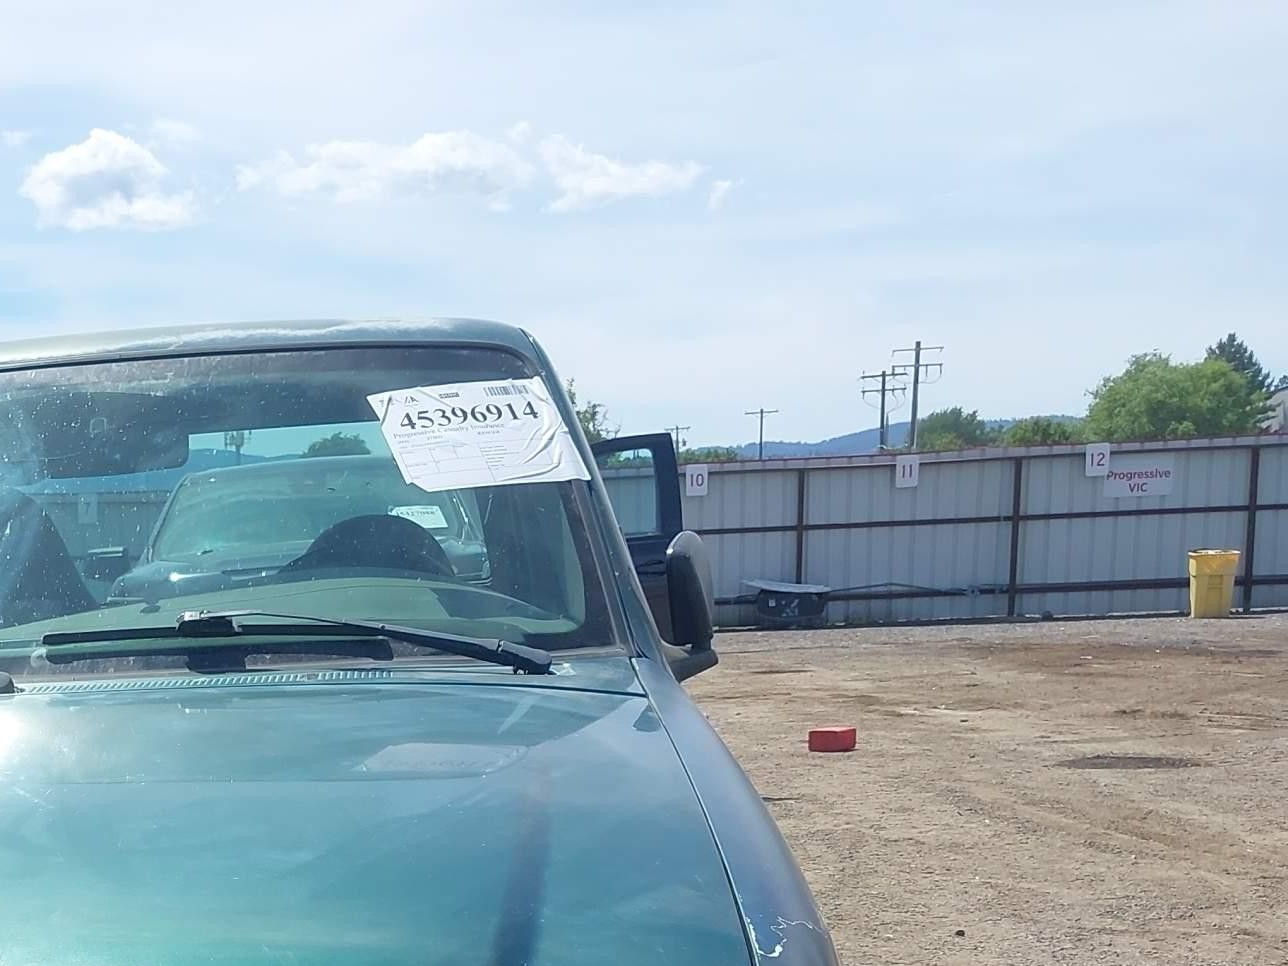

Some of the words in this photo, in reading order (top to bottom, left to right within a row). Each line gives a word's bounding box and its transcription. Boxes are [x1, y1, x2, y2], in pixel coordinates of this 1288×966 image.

[400, 401, 540, 430] 45396914
[1090, 452, 1106, 467] 12
[902, 463, 913, 478] 11
[1106, 468, 1172, 481] Progressive
[689, 473, 705, 488] 10
[1128, 482, 1148, 493] VIC
